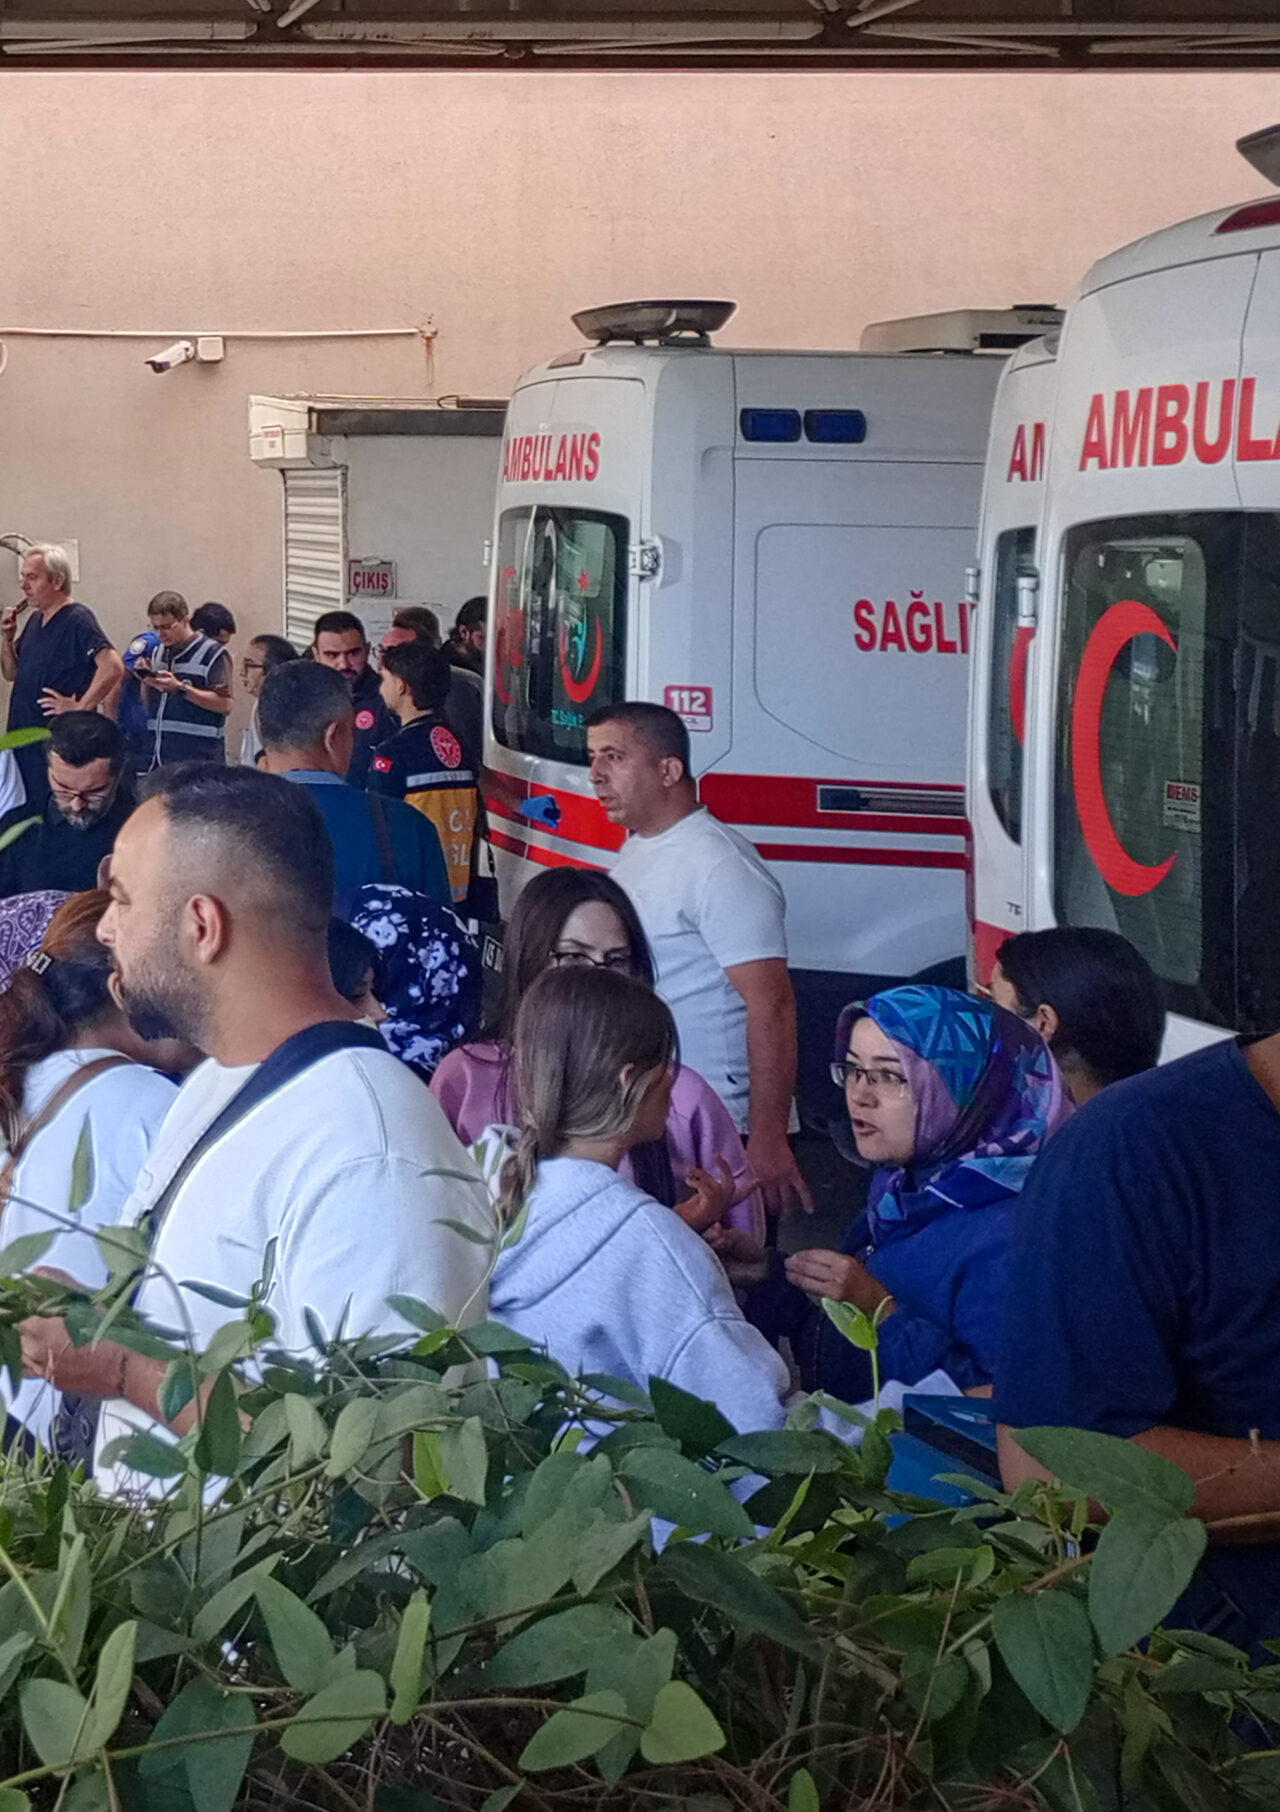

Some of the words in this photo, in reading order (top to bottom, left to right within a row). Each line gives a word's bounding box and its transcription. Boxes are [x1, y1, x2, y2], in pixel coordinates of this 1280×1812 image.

[1078, 377, 1280, 472] AMBUL
[502, 432, 601, 482] AMBULANS
[353, 571, 389, 595] ÇIKIŞ
[854, 590, 977, 654] SAĞLI
[670, 690, 707, 713] 112
